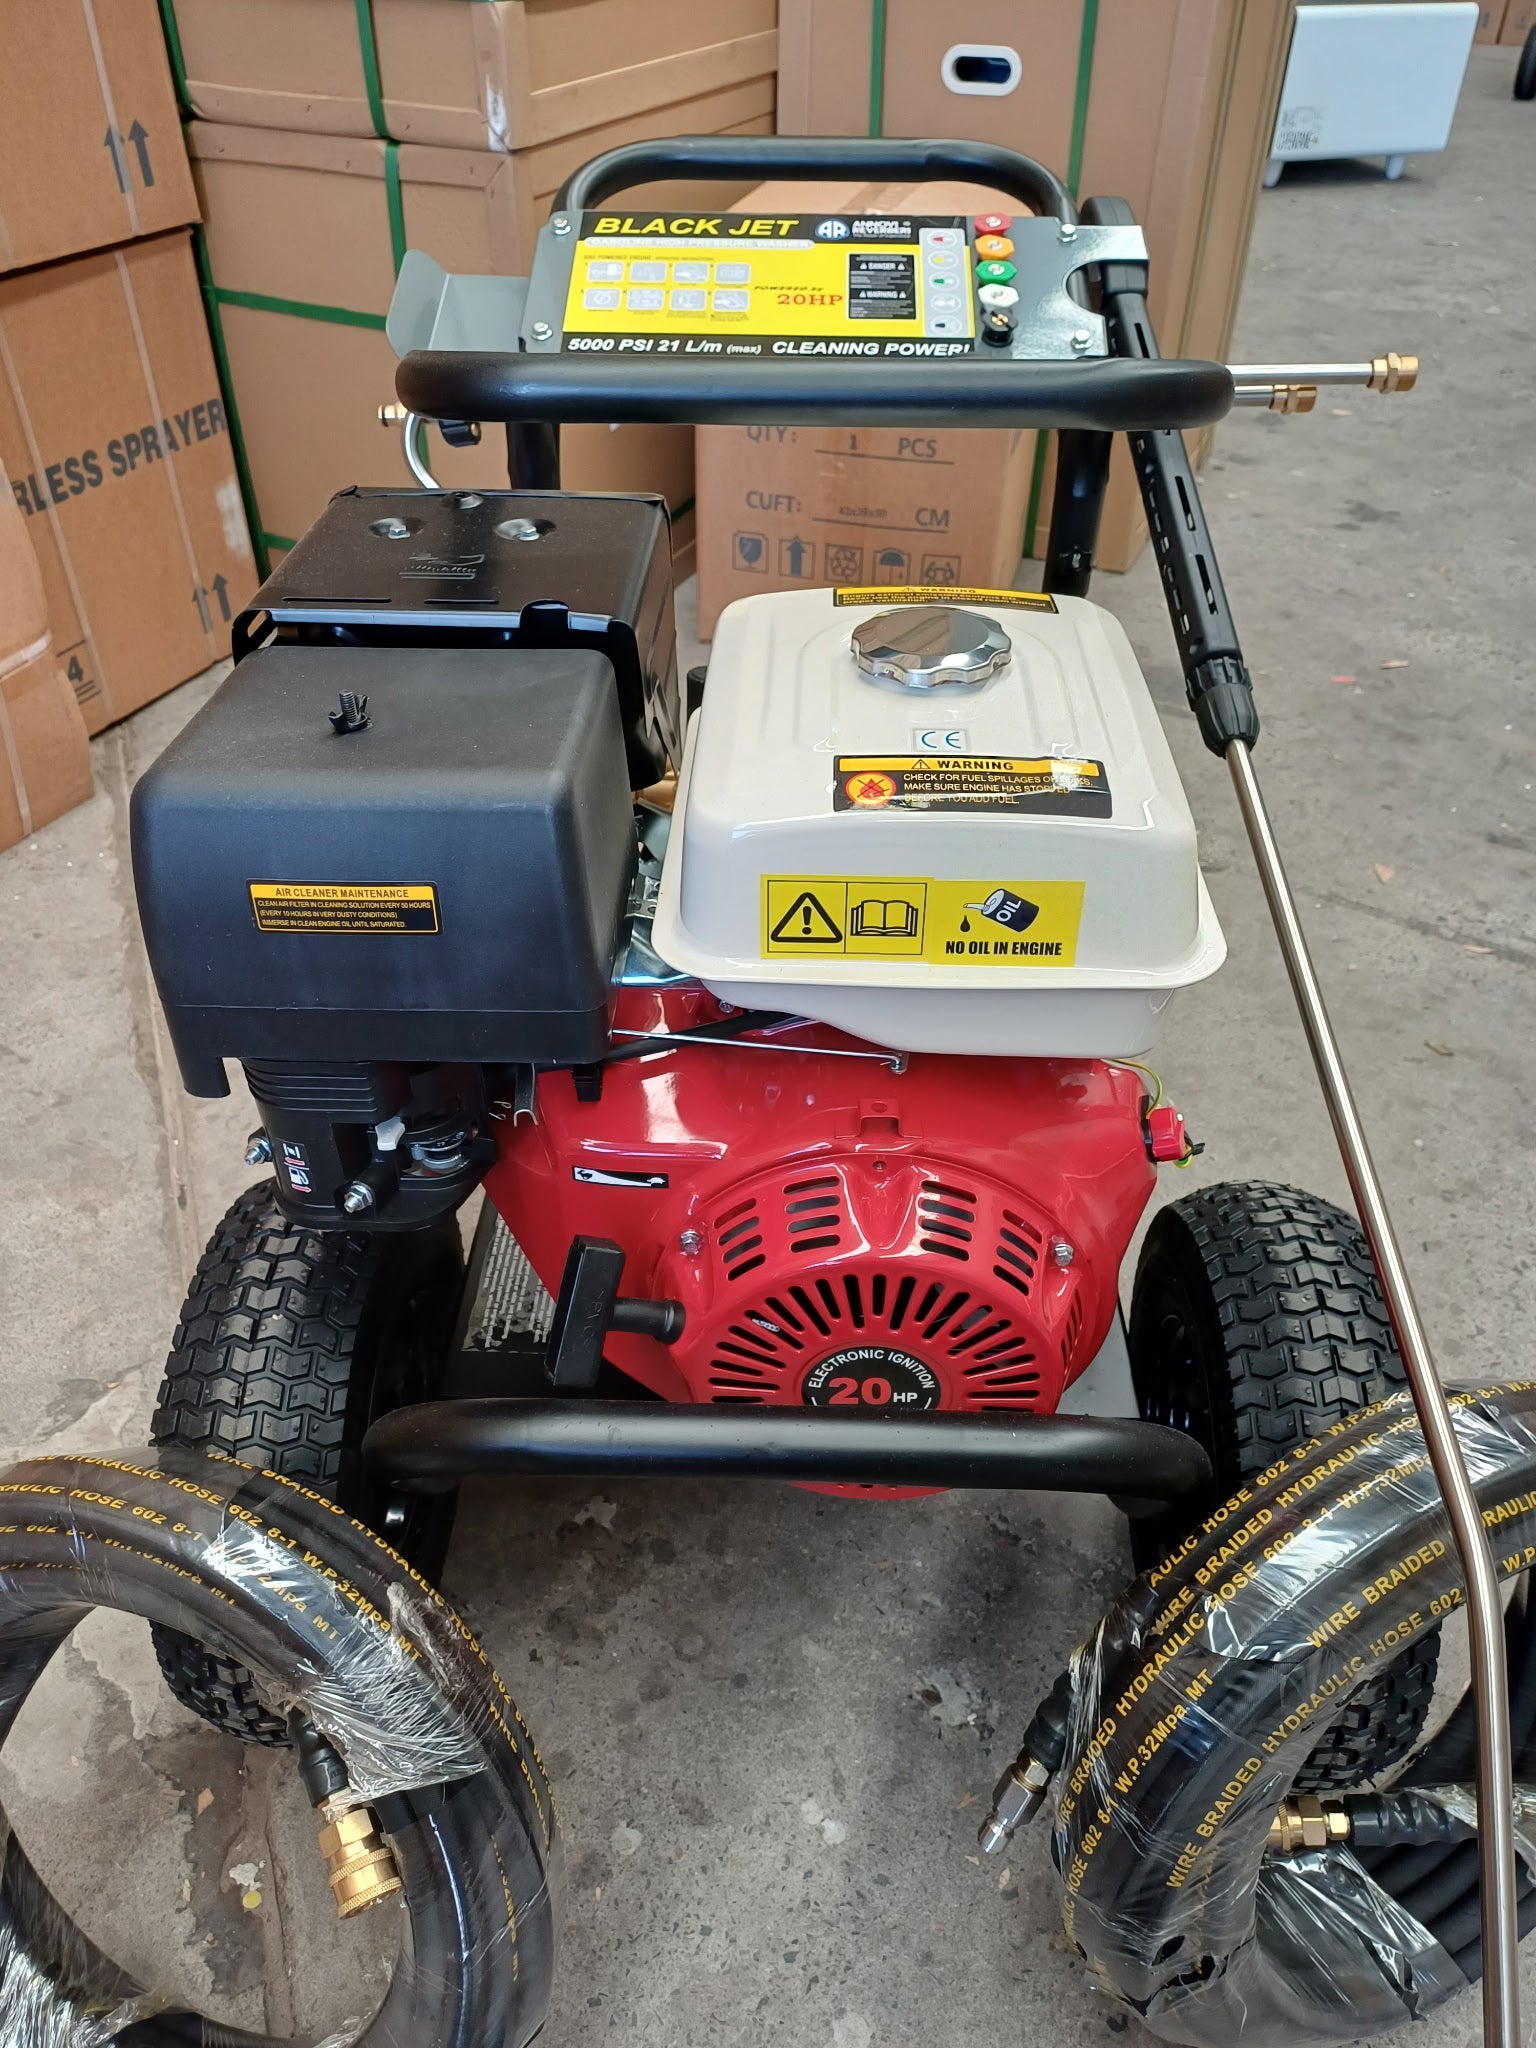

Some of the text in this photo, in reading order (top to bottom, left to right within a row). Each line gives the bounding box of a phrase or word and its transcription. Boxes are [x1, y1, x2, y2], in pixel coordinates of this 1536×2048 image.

[593, 217, 800, 237] BLACK JET
[777, 293, 843, 306] 20HP
[567, 338, 971, 357] 5000 PSI 21 L/m (max) CLEANING POWER!
[107, 398, 228, 478] SPRAYER
[897, 436, 938, 459] PCS
[745, 490, 803, 514] CUFT:
[914, 507, 951, 528] CM
[67, 655, 85, 683] 4
[920, 731, 962, 749] CE
[903, 773, 938, 782] CHECK
[939, 773, 960, 782] FOR
[961, 774, 987, 783] FUEL
[987, 774, 1042, 784] SPILLAGES
[937, 759, 1014, 771] WARNING
[904, 782, 932, 791] MAKE
[933, 783, 961, 791] SURE
[962, 784, 1000, 792] ENGINE
[1001, 785, 1022, 793] HAS
[275, 888, 410, 898] AIR CLEANER MAINTENANCE
[317, 901, 349, 909] CLEANING
[260, 909, 282, 917] (EVERY
[357, 911, 398, 919] CONDITIONS)
[995, 900, 1022, 923] OIL
[945, 940, 1063, 956] NO OIL IN ENGINE
[808, 1349, 936, 1389] ELECTRONIC IGNITION
[828, 1376, 918, 1405] 20 HP
[1202, 1487, 1253, 1535] HOSE
[1256, 1460, 1290, 1487] 602
[1292, 1438, 1323, 1460] 8-1
[1151, 1585, 1196, 1636] WIRE
[1194, 1508, 1274, 1586] BRAIDED
[1275, 1432, 1385, 1509] HYDRAULIC
[1476, 1385, 1505, 1400] 8-1
[260, 1468, 346, 1517] BRAIDED
[350, 1517, 447, 1608] HYDRAULIC
[68, 1488, 129, 1510] HOSE
[131, 1505, 169, 1526] 602
[171, 1521, 205, 1542] 8-1
[312, 1614, 343, 1641] MT
[168, 1476, 226, 1506] HOSE
[227, 1503, 264, 1529] 602
[266, 1526, 298, 1550] 8-1
[302, 1550, 393, 1633] W.P.32Mpa
[397, 1635, 423, 1662] MT
[1306, 1600, 1362, 1650] WIRE
[1360, 1538, 1447, 1606] BRAIDED
[1069, 1717, 1118, 1796] BRAIDED
[1115, 1612, 1206, 1718] HYDRAULIC
[1209, 1560, 1261, 1612] HOSE
[1165, 1841, 1203, 1889] WIRE
[1195, 1756, 1263, 1839] BRAIDED
[1261, 1655, 1367, 1754] HYDRAULIC
[1368, 1611, 1425, 1658] HOSE
[1428, 1586, 1463, 1617] 602
[1080, 1824, 1103, 1855] 602
[1114, 1703, 1188, 1796] W.P.32Mpa
[1185, 1668, 1215, 1702] MT
